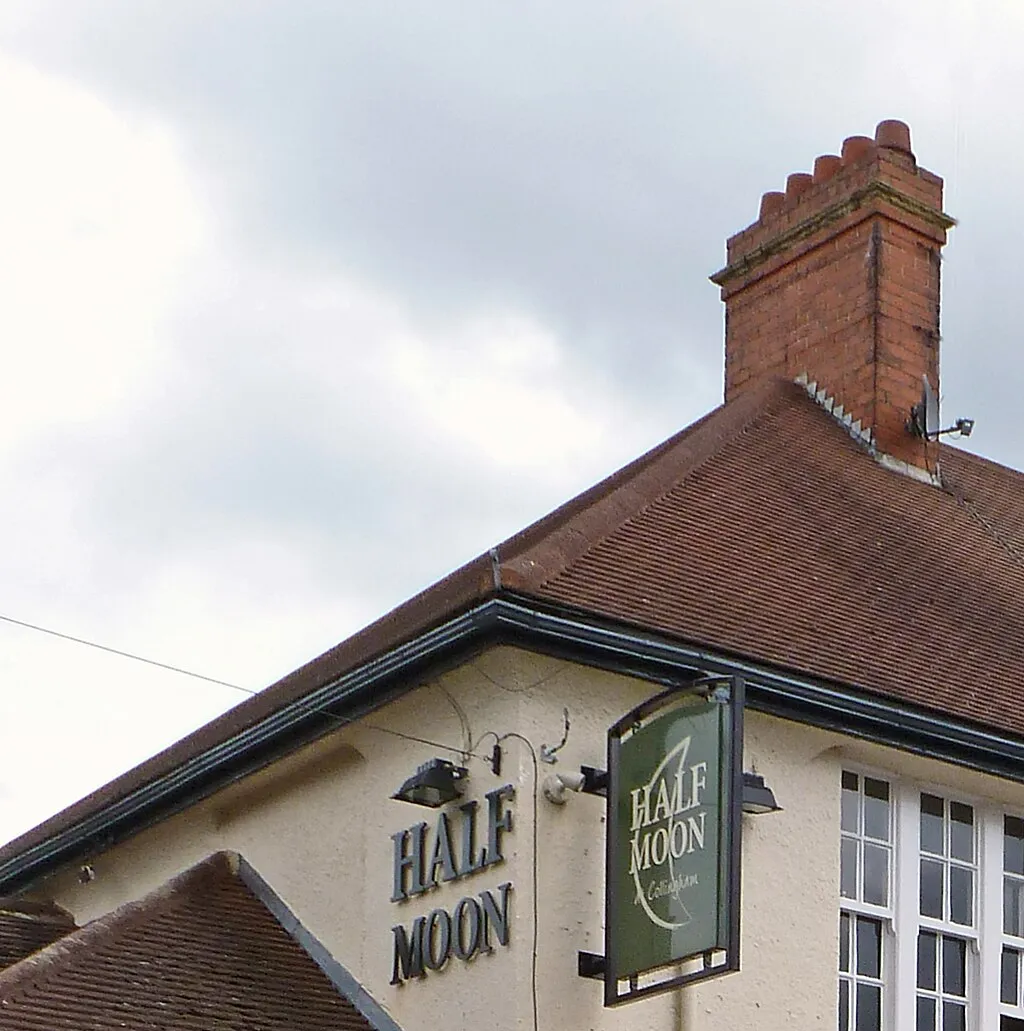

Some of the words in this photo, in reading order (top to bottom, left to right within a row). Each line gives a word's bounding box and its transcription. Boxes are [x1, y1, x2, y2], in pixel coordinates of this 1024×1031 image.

[630, 762, 707, 831] HALF
[390, 783, 515, 903] HALF
[629, 812, 707, 874] MOON
[389, 882, 514, 985] MOON
